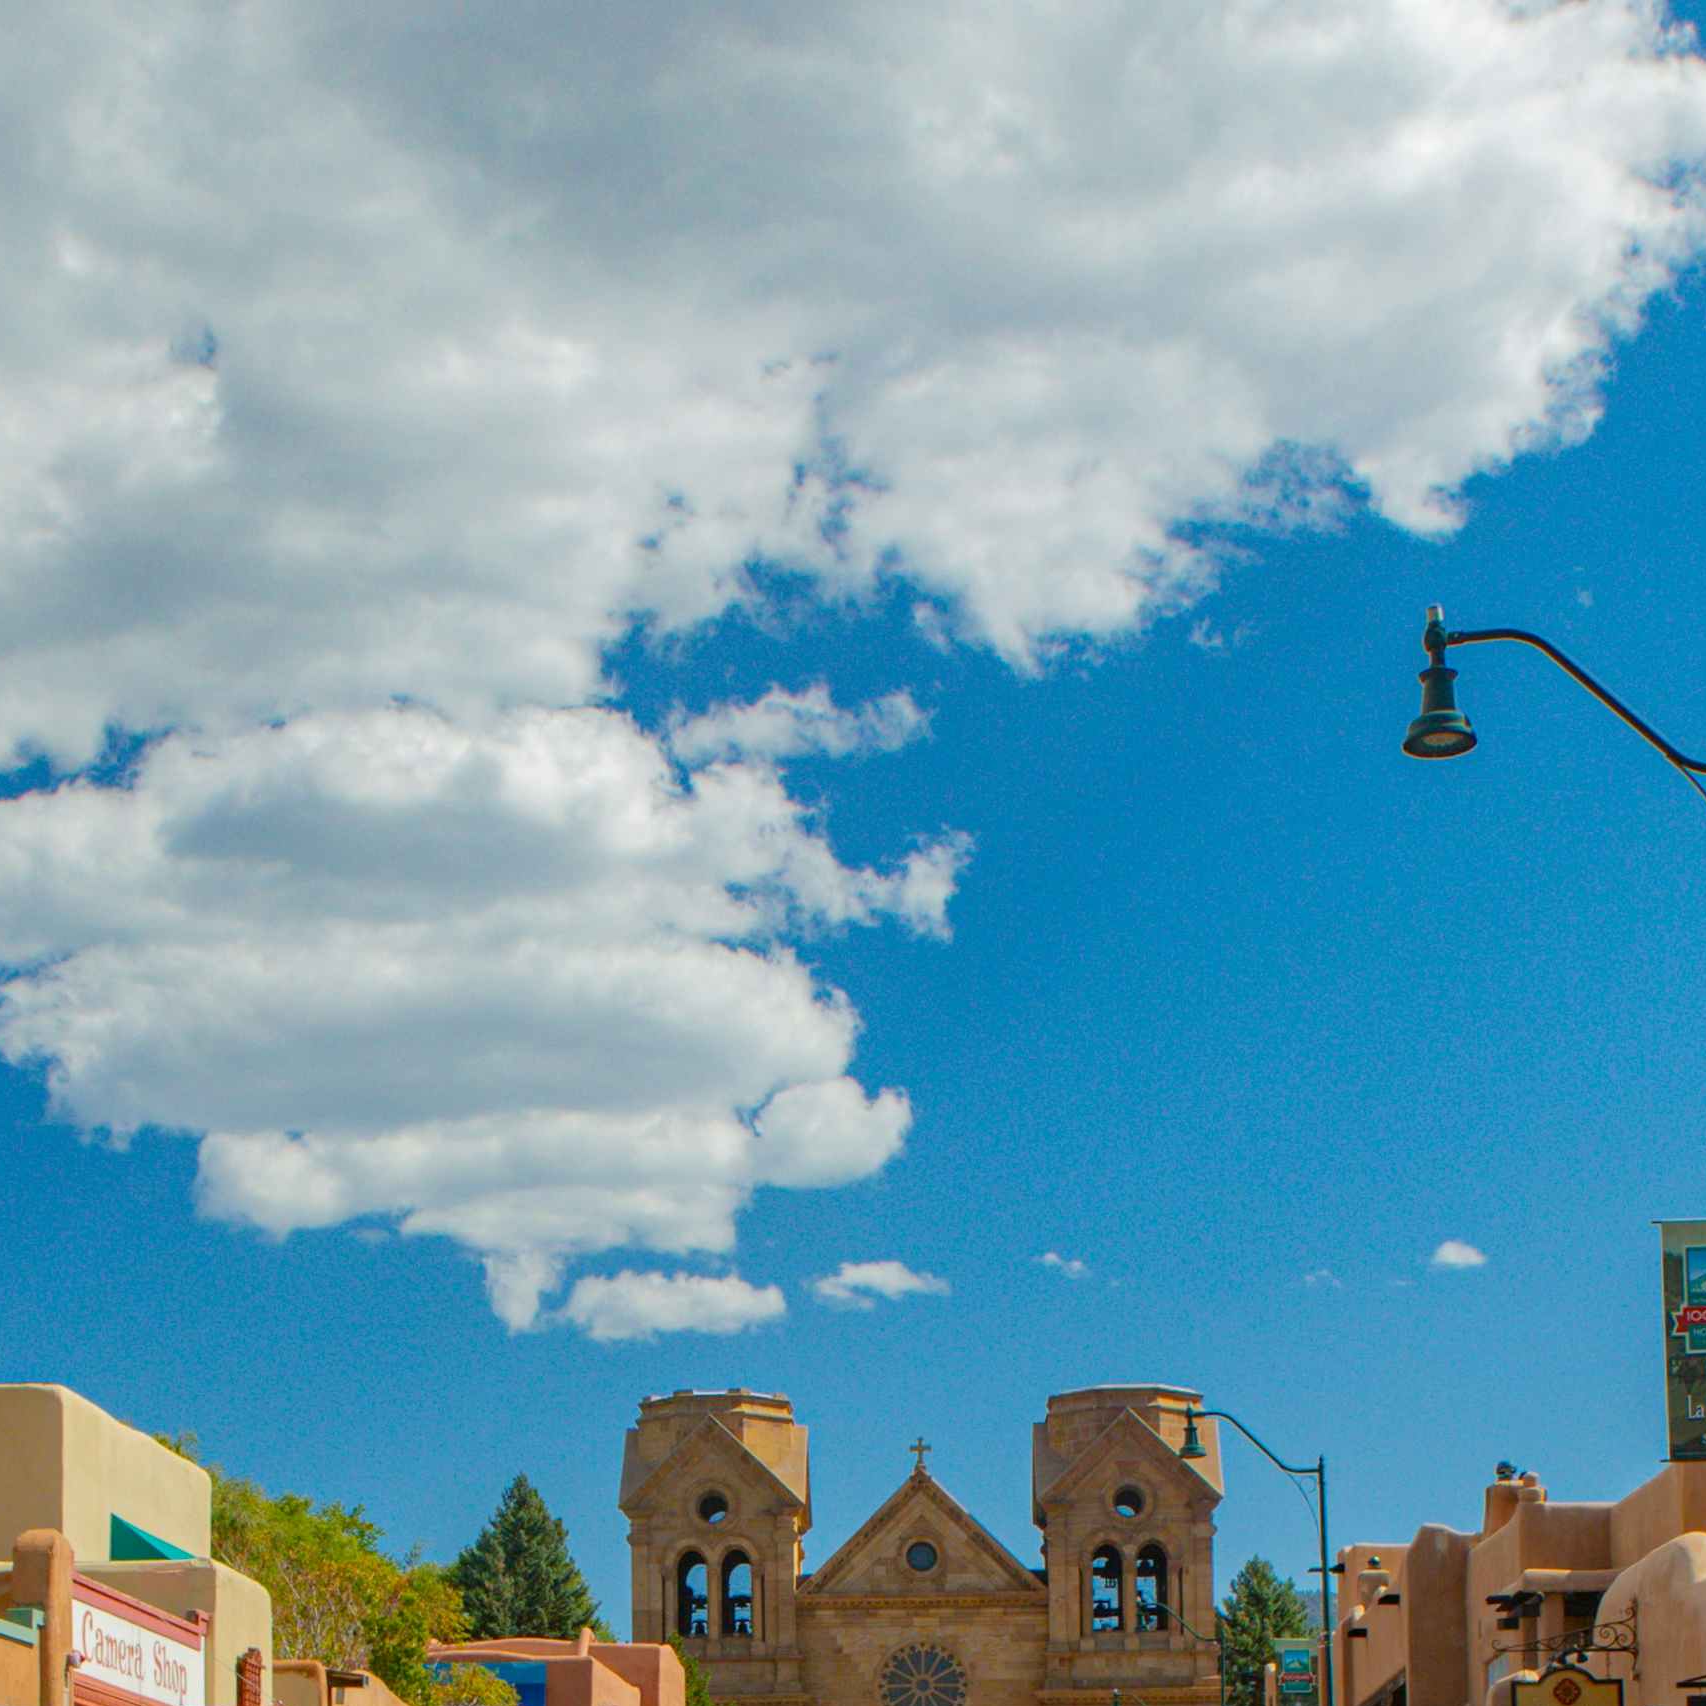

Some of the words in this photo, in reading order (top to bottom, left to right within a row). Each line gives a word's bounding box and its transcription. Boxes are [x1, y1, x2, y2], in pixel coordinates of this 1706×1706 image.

[1687, 1394, 1705, 1418] La
[82, 1609, 145, 1681] Camera
[153, 1640, 188, 1706] Shop
